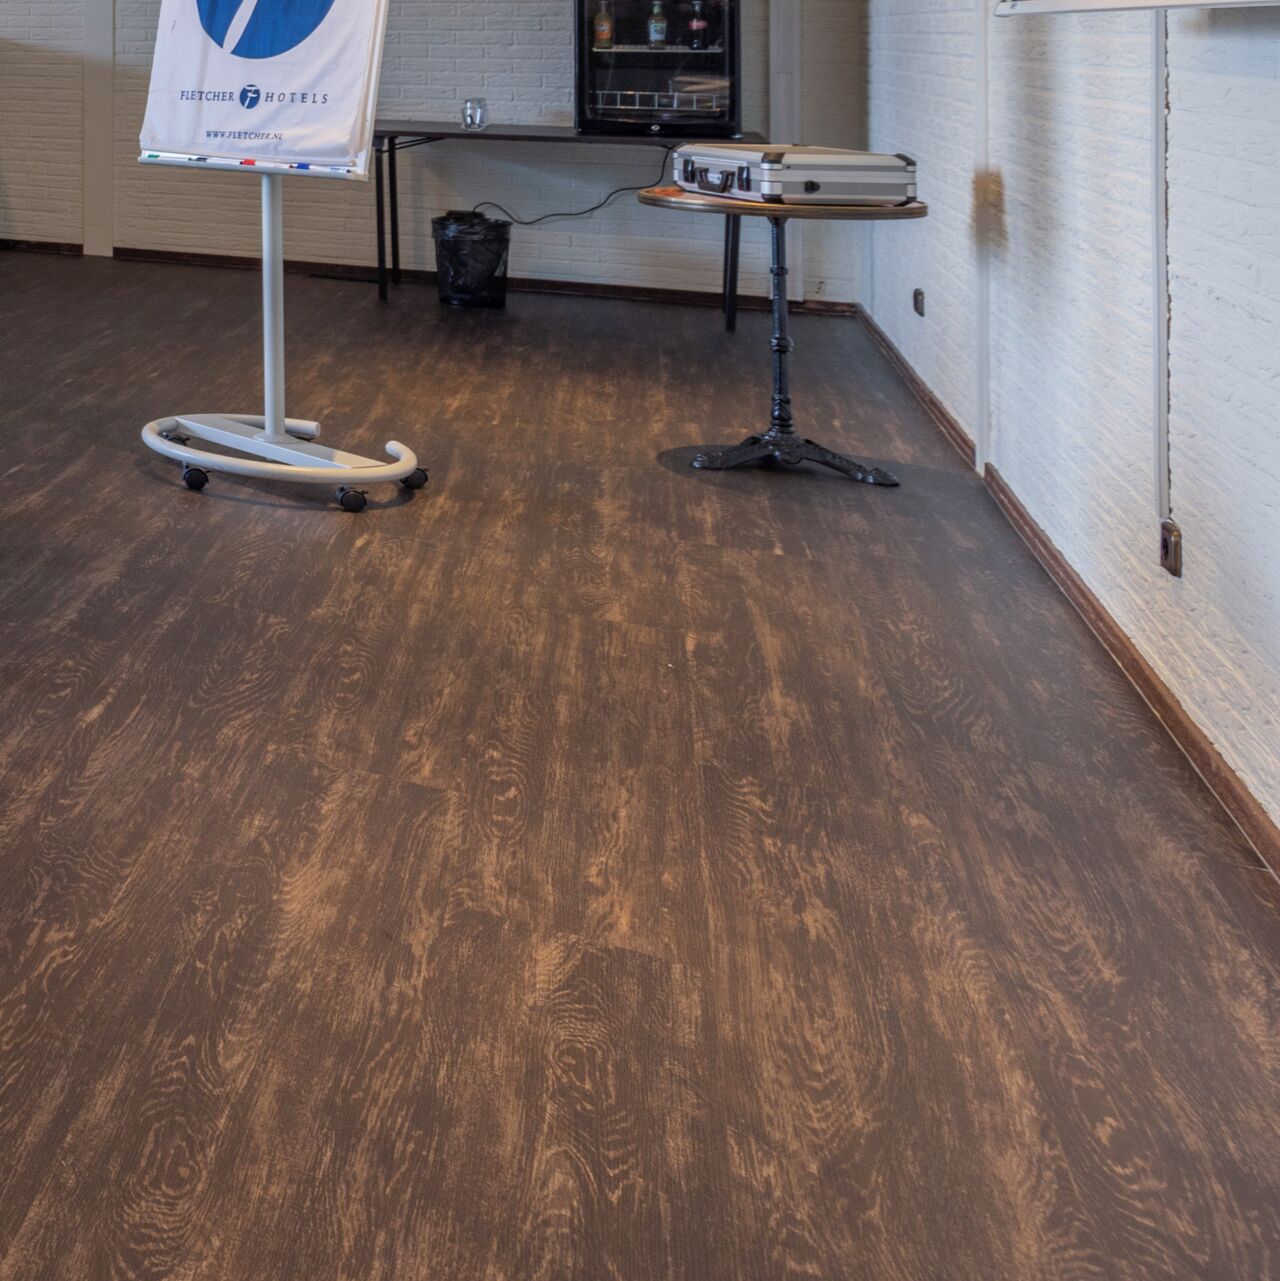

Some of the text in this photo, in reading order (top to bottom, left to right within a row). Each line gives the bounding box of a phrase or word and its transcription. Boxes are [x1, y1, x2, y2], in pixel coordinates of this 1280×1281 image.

[180, 90, 328, 104] FLETCHER HOTELS
[205, 130, 284, 140] WWW.FLETCHER.NL
